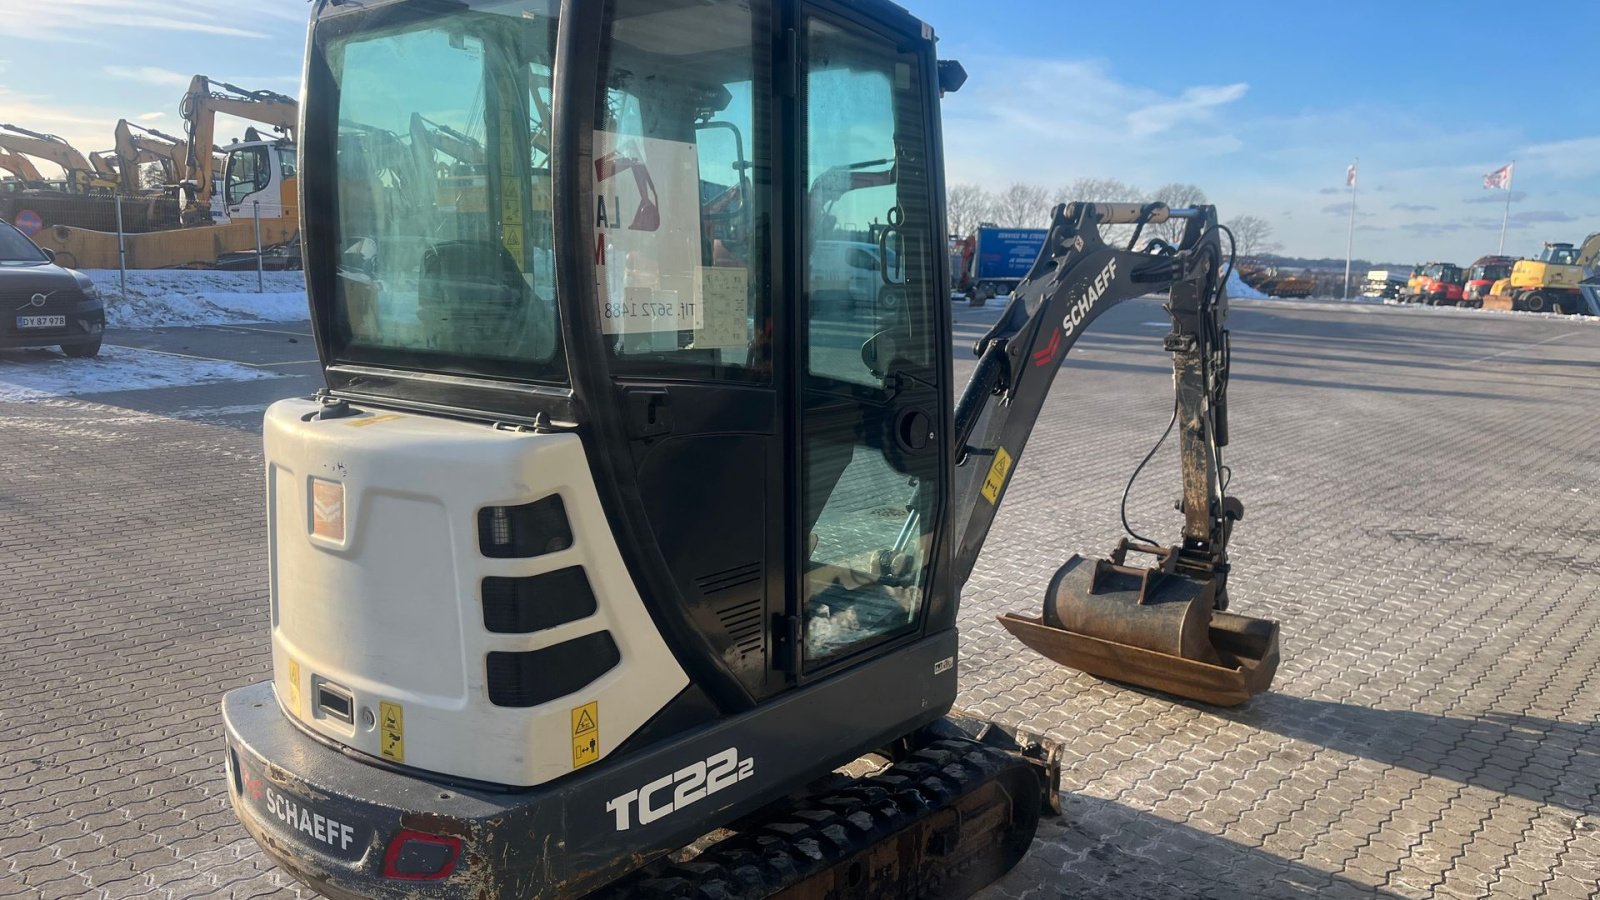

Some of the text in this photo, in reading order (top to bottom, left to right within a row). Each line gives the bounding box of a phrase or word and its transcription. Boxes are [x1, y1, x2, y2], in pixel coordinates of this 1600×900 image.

[36, 317, 47, 326] 87
[1062, 256, 1117, 337] SCHAEFF
[266, 787, 354, 850] SCHAEFF
